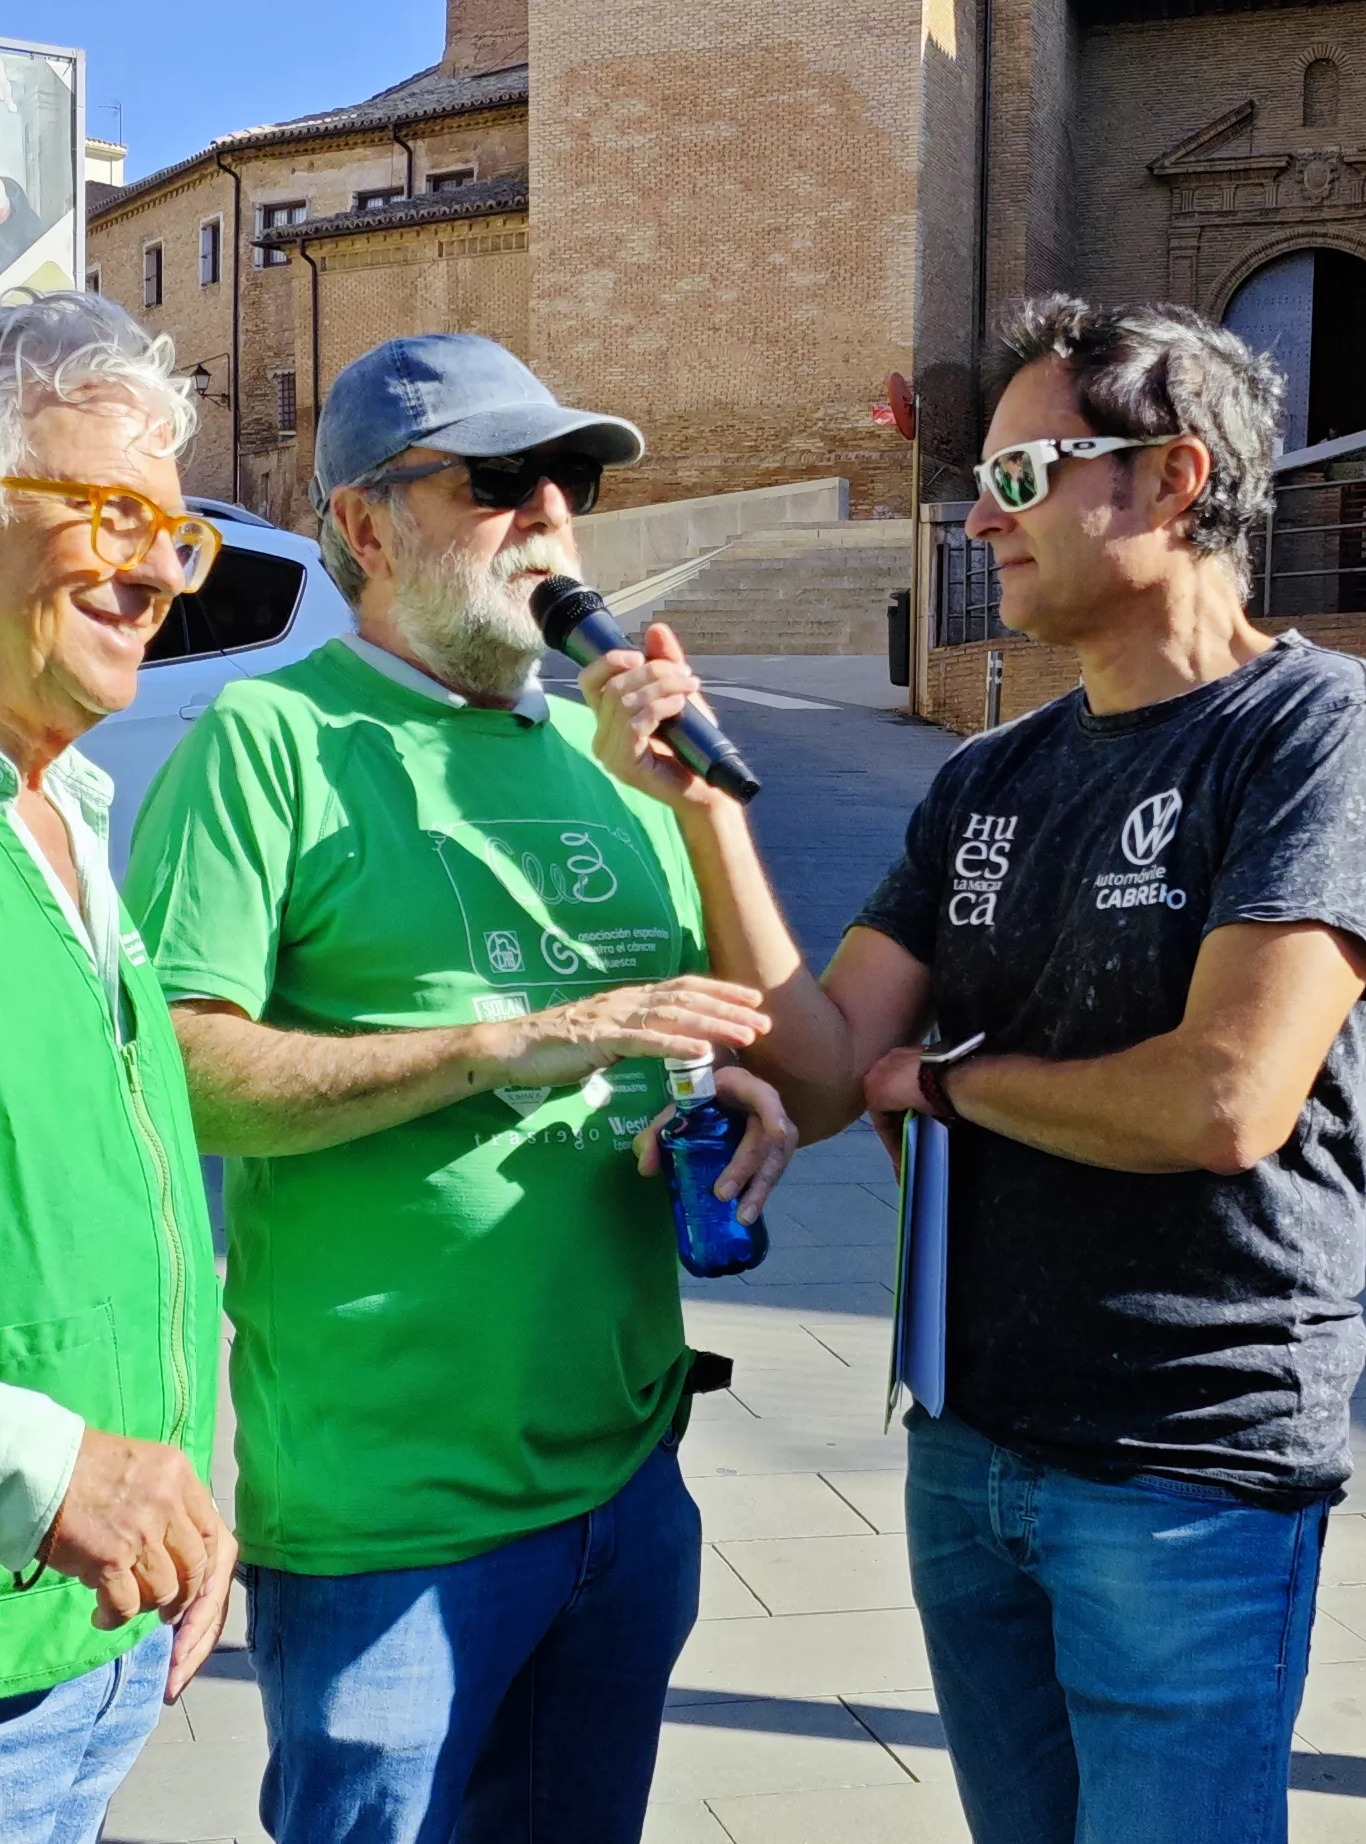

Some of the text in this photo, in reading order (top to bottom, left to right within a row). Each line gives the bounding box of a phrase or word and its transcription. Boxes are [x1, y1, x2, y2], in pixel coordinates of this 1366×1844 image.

[962, 813, 1019, 841] Hu
[955, 841, 1011, 880] es
[948, 892, 998, 926] ca
